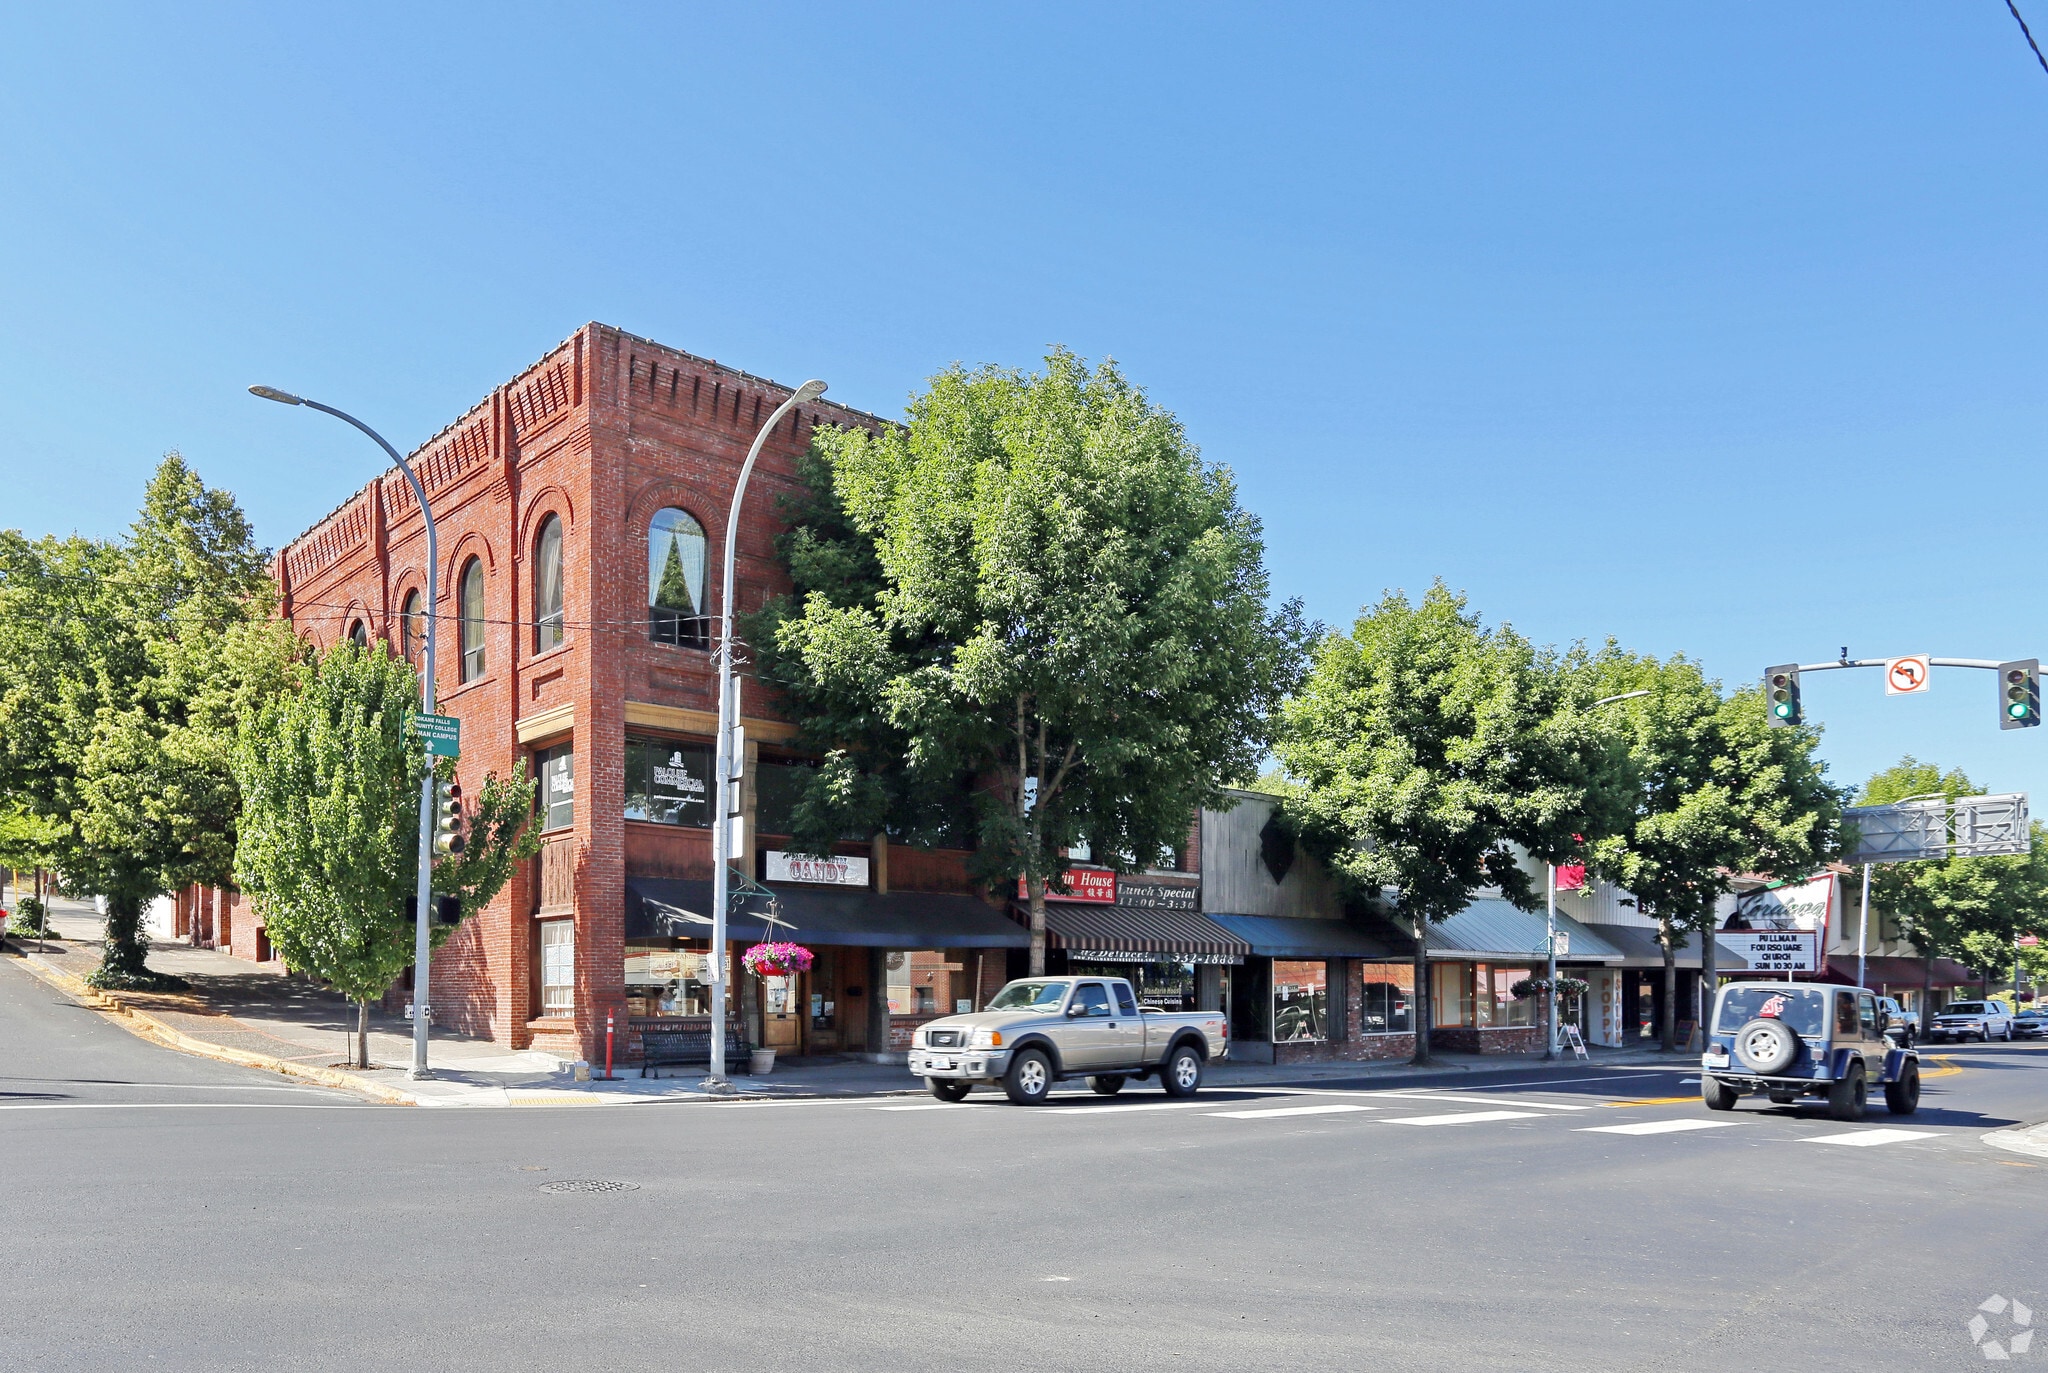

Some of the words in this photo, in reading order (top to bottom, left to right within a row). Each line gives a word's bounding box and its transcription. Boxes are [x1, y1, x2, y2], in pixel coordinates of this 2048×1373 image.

[432, 732, 457, 740] CAMPUS
[790, 861, 848, 883] CANDY
[1080, 872, 1113, 887] House
[1118, 883, 1155, 896] Lunch
[1157, 886, 1197, 900] Special
[1758, 934, 1797, 942] PULLMAN
[1172, 952, 1235, 965] 332-1888
[1761, 953, 1792, 961] CHURCH
[1754, 962, 1771, 970] SUN
[1793, 962, 1806, 970] AM
[1143, 997, 1163, 1005] Chinese
[1163, 997, 1182, 1005] Cuisine
[1602, 979, 1611, 1043] POPPY
